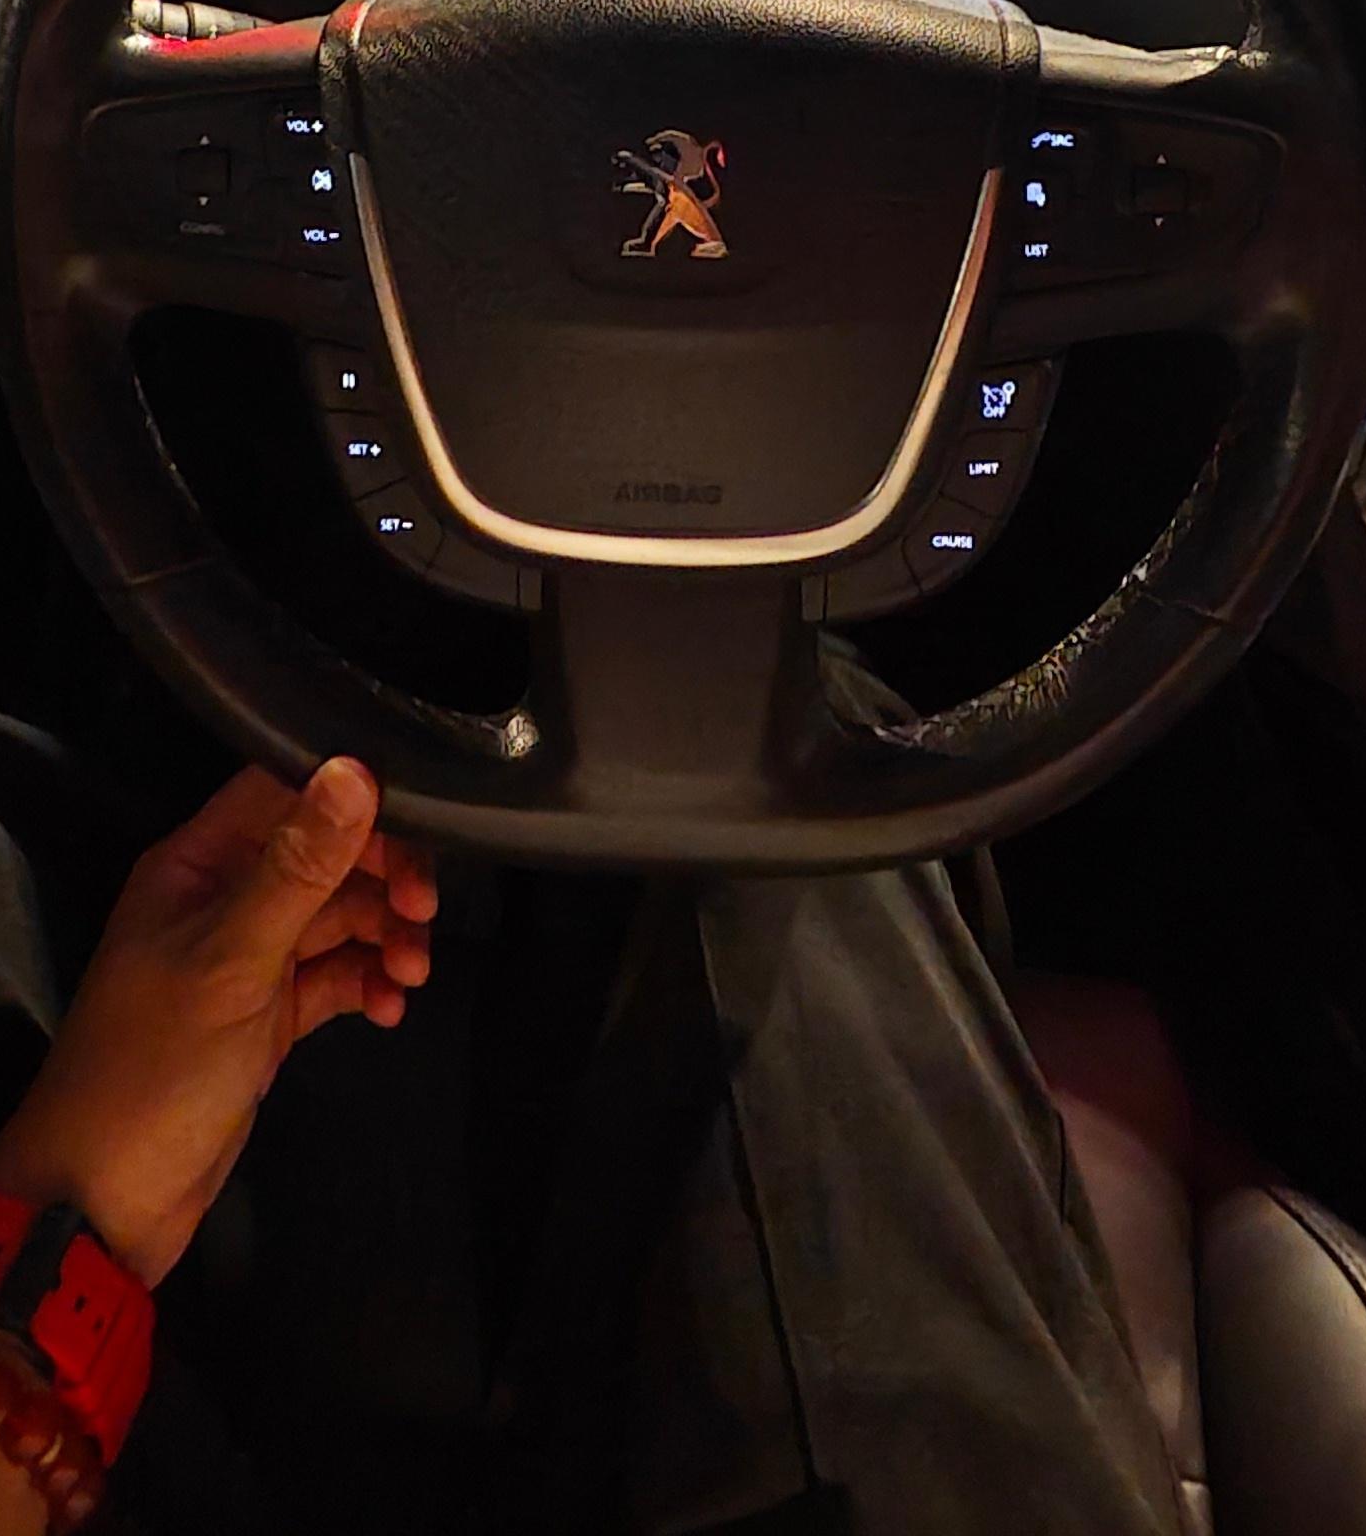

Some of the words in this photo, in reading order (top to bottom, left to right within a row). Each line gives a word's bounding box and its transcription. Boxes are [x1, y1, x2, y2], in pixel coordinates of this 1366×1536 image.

[286, 120, 311, 133] VOL
[1050, 134, 1074, 147] SRC
[303, 229, 327, 242] VOL
[1024, 243, 1050, 257] LIST
[348, 443, 369, 456] SET
[968, 462, 999, 476] LIMIT
[613, 481, 724, 506] AIRBAG
[379, 518, 400, 532] SET
